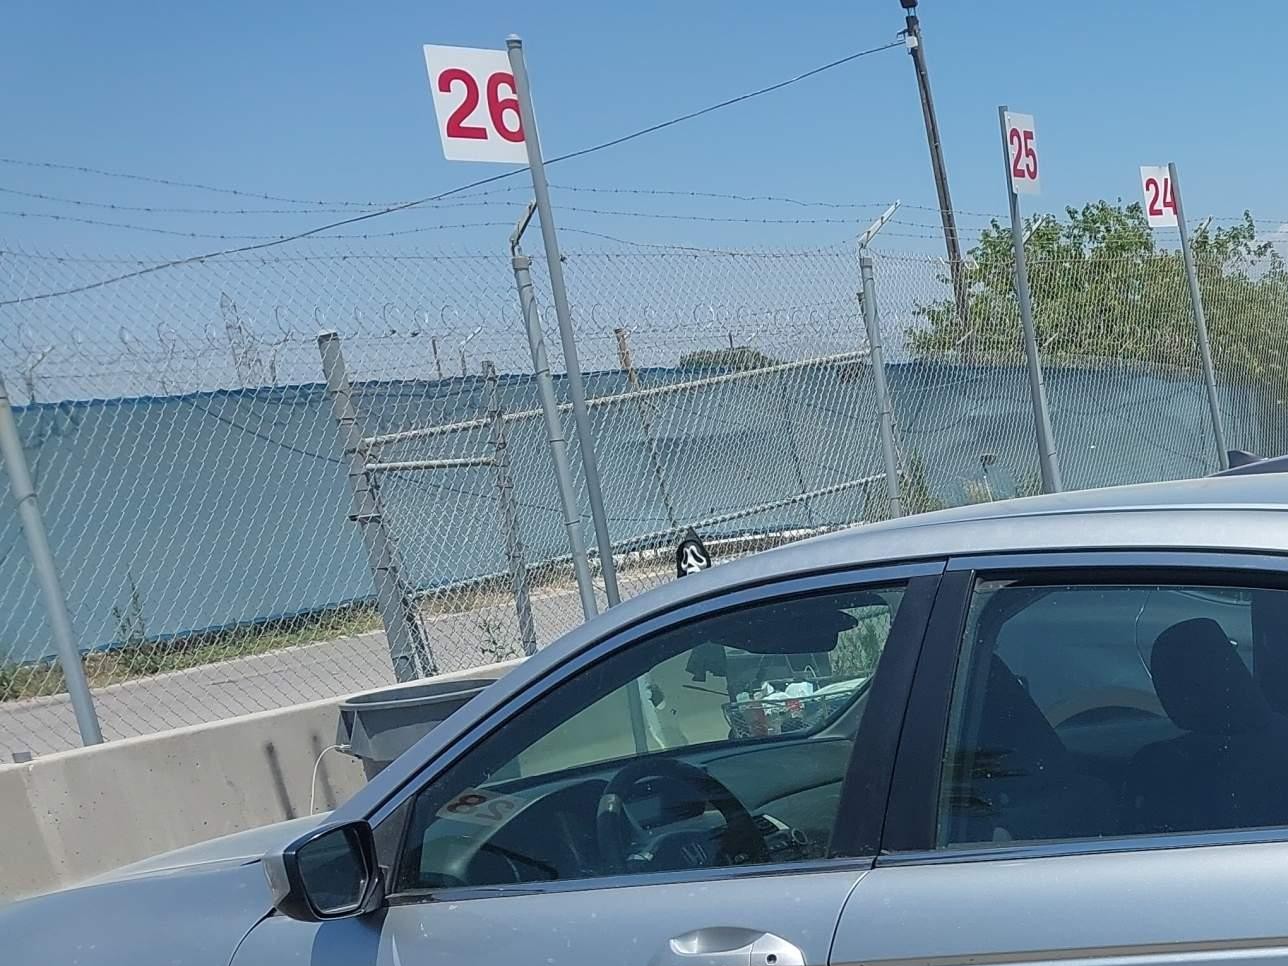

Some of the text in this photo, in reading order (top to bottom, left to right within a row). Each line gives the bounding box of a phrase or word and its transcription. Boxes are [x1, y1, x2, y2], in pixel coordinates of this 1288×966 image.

[438, 68, 526, 142] 26
[1009, 127, 1038, 180] 25
[1145, 177, 1178, 217] 24
